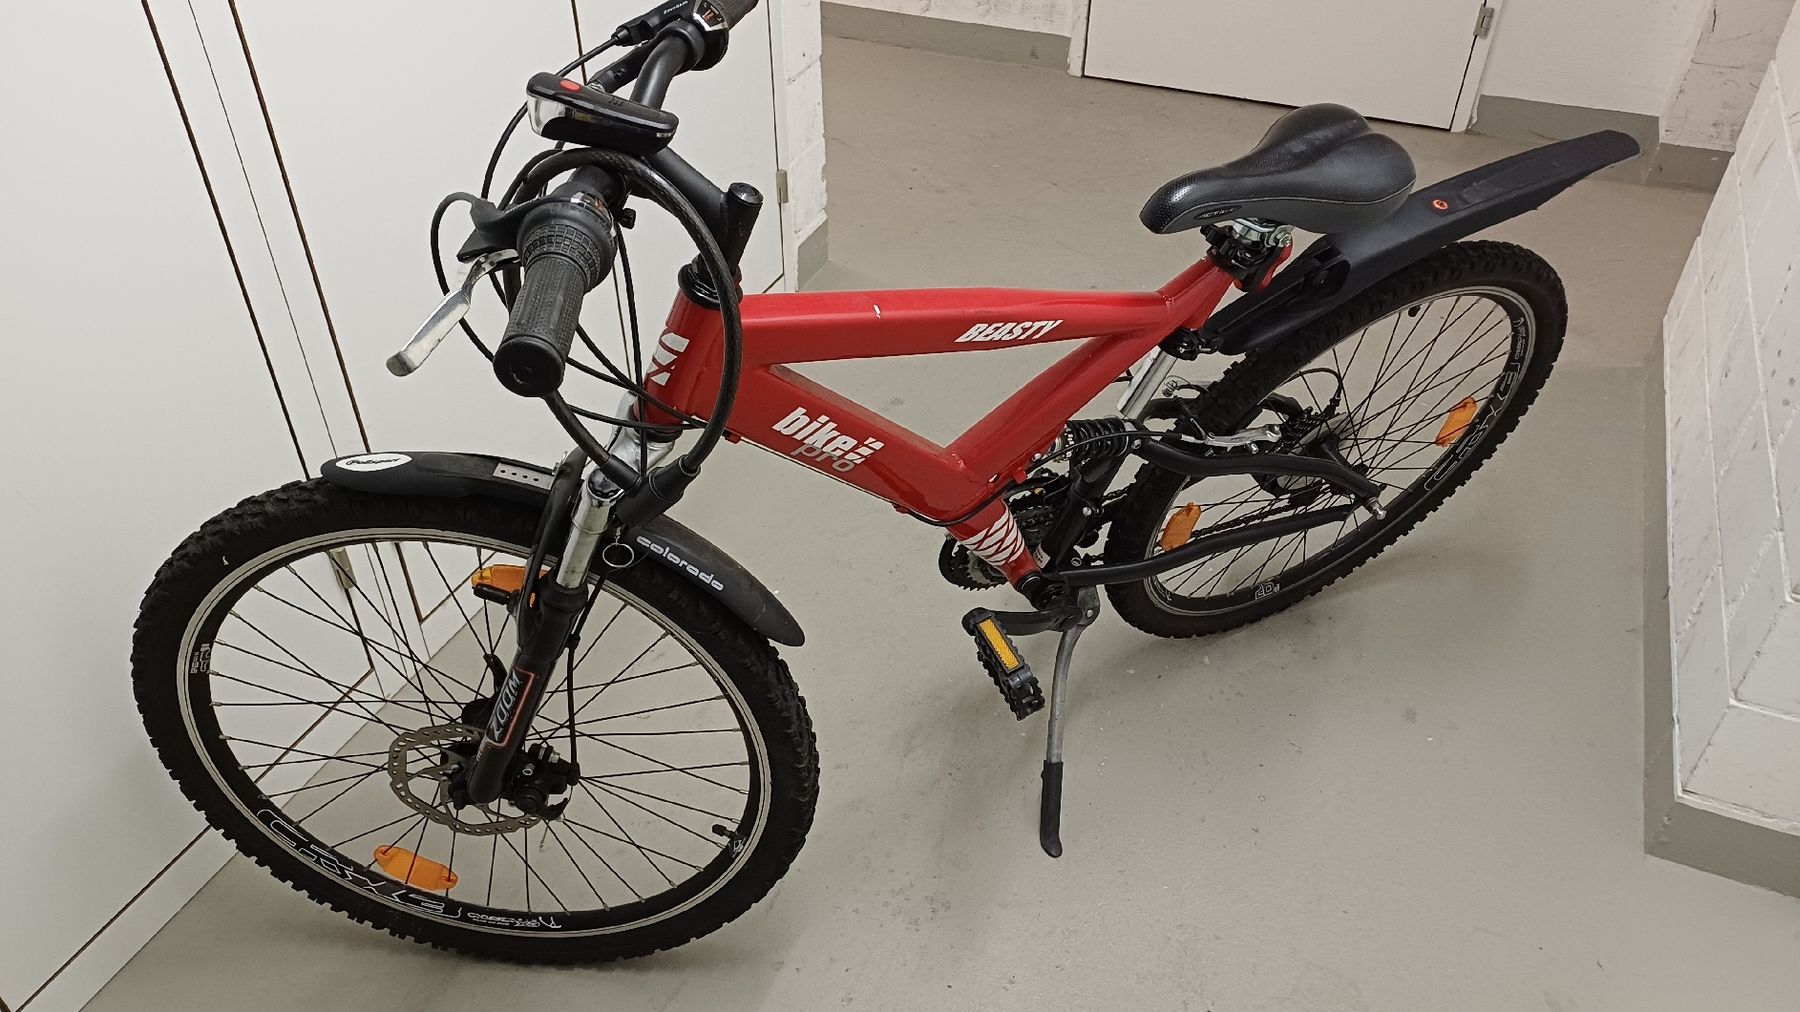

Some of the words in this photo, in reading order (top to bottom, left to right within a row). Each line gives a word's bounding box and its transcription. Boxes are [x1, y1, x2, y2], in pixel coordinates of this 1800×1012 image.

[954, 320, 1064, 342] BEASTY
[771, 406, 858, 457] bike
[790, 443, 855, 472] pro
[636, 535, 724, 591] colorado
[492, 670, 523, 741] ZOOM
